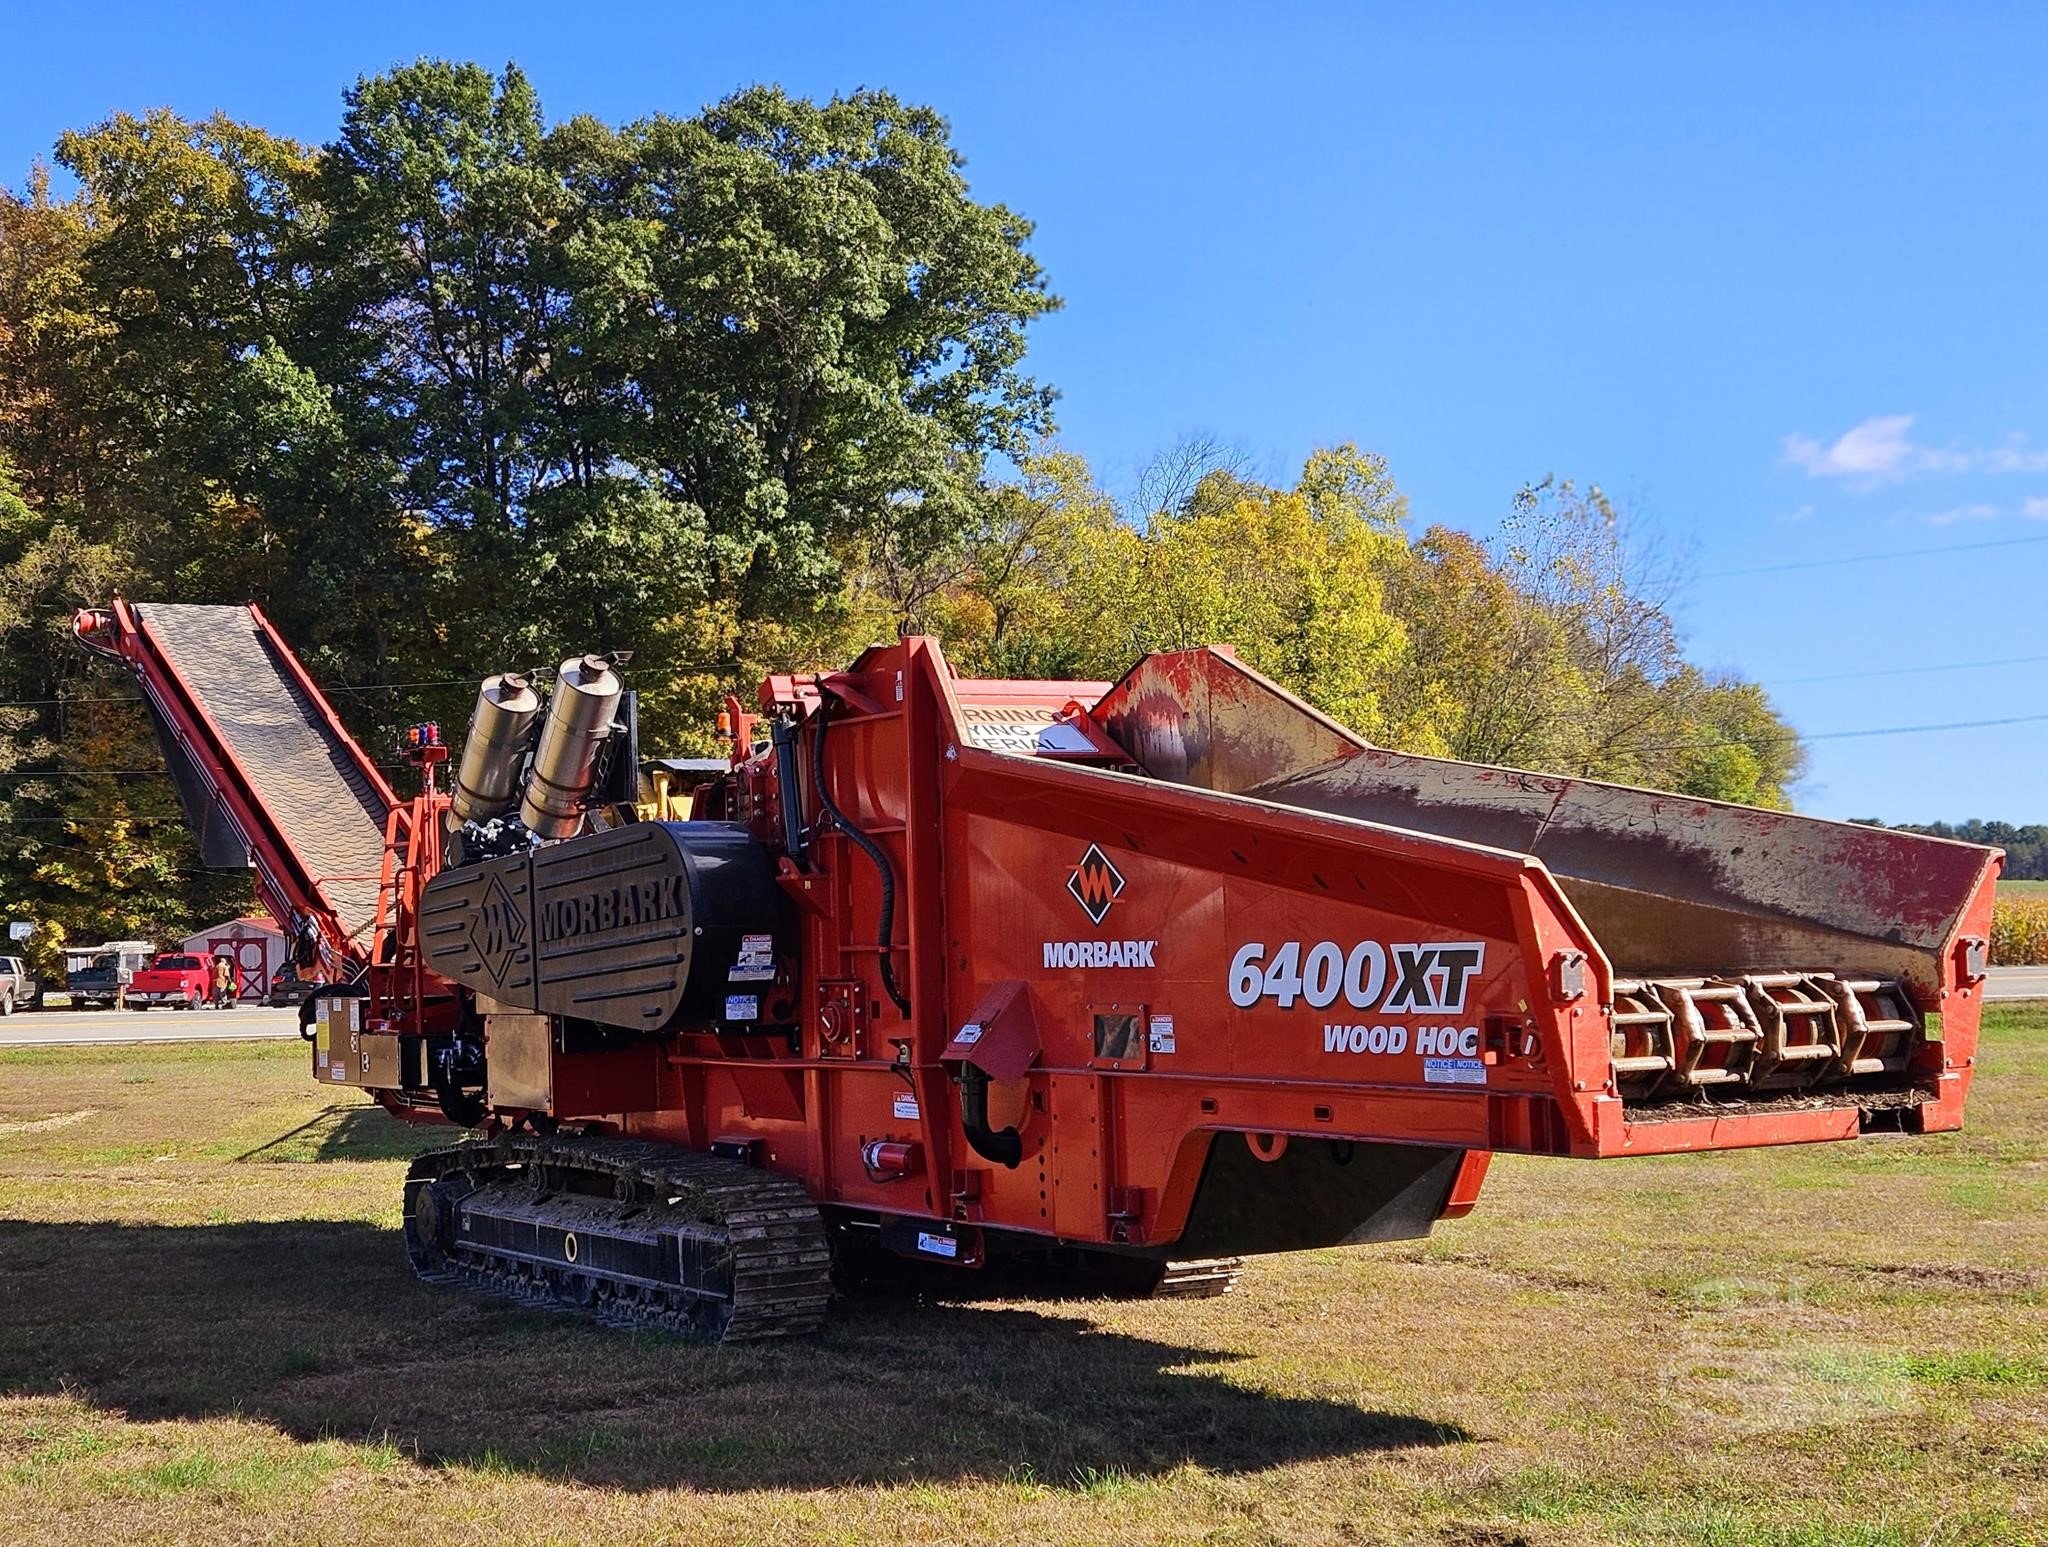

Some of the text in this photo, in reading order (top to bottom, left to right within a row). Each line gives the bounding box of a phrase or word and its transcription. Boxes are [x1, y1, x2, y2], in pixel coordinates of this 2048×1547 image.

[538, 874, 684, 942] MORBARK
[1042, 940, 1157, 969] MORBARK
[727, 995, 755, 1004] NOTICE
[1323, 1024, 1480, 1057] WOOD HOG
[1425, 1059, 1454, 1068] NOTICE
